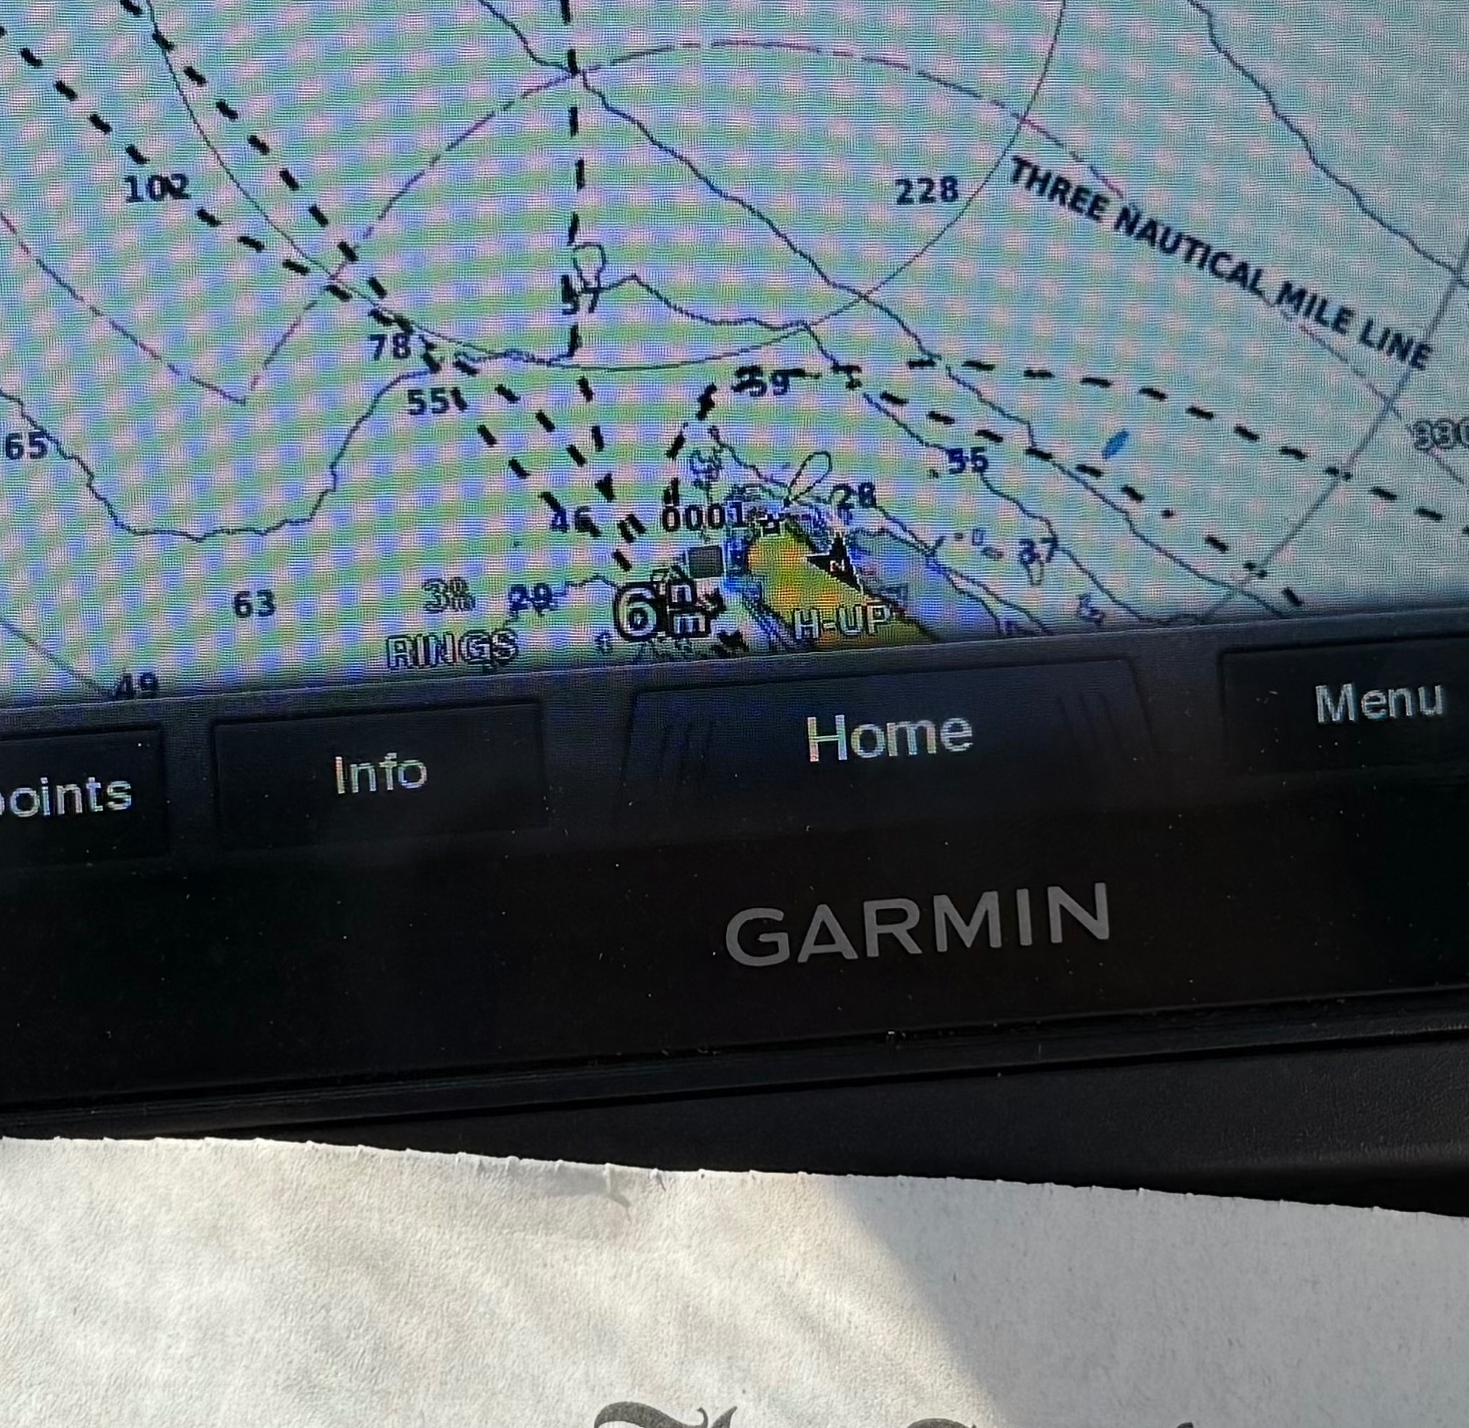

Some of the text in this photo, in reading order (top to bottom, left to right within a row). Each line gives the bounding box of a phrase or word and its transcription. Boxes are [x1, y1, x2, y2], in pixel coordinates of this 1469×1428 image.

[122, 174, 190, 204] 102
[895, 176, 959, 207] 228
[1010, 155, 1433, 370] THREE NAUTICAL MILE LINE
[369, 333, 411, 360] 78
[407, 388, 449, 415] 55
[5, 432, 48, 461] 65
[662, 502, 747, 532] 0001
[234, 589, 276, 618] 63
[793, 601, 891, 639] H-UP
[387, 625, 520, 672] RINGS
[115, 672, 159, 699] 49
[1314, 681, 1448, 723] Menu
[806, 713, 974, 763] Home
[334, 752, 429, 796] Info
[726, 882, 1110, 967] GARMIN
